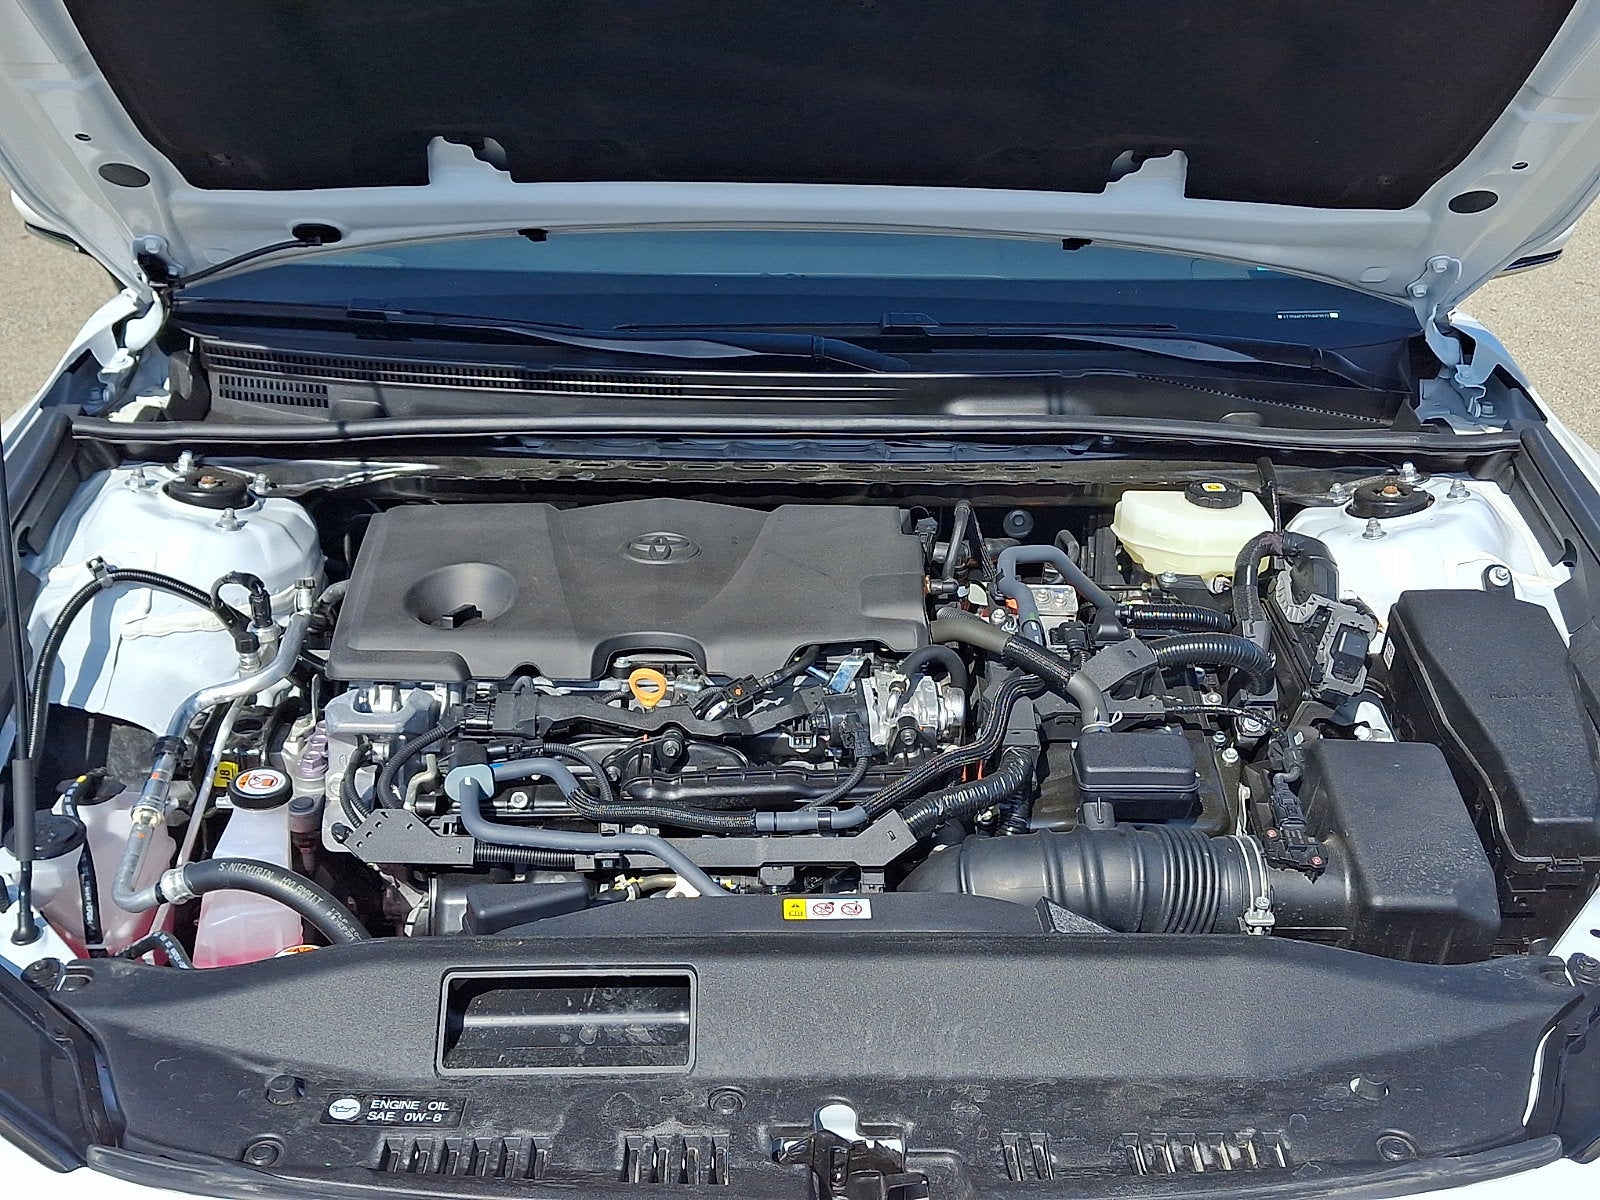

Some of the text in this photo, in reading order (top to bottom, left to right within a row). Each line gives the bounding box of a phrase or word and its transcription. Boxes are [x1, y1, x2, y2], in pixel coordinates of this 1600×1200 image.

[370, 1099, 450, 1112] ENGINE OIL
[366, 1111, 443, 1123] SAE 0W-8
